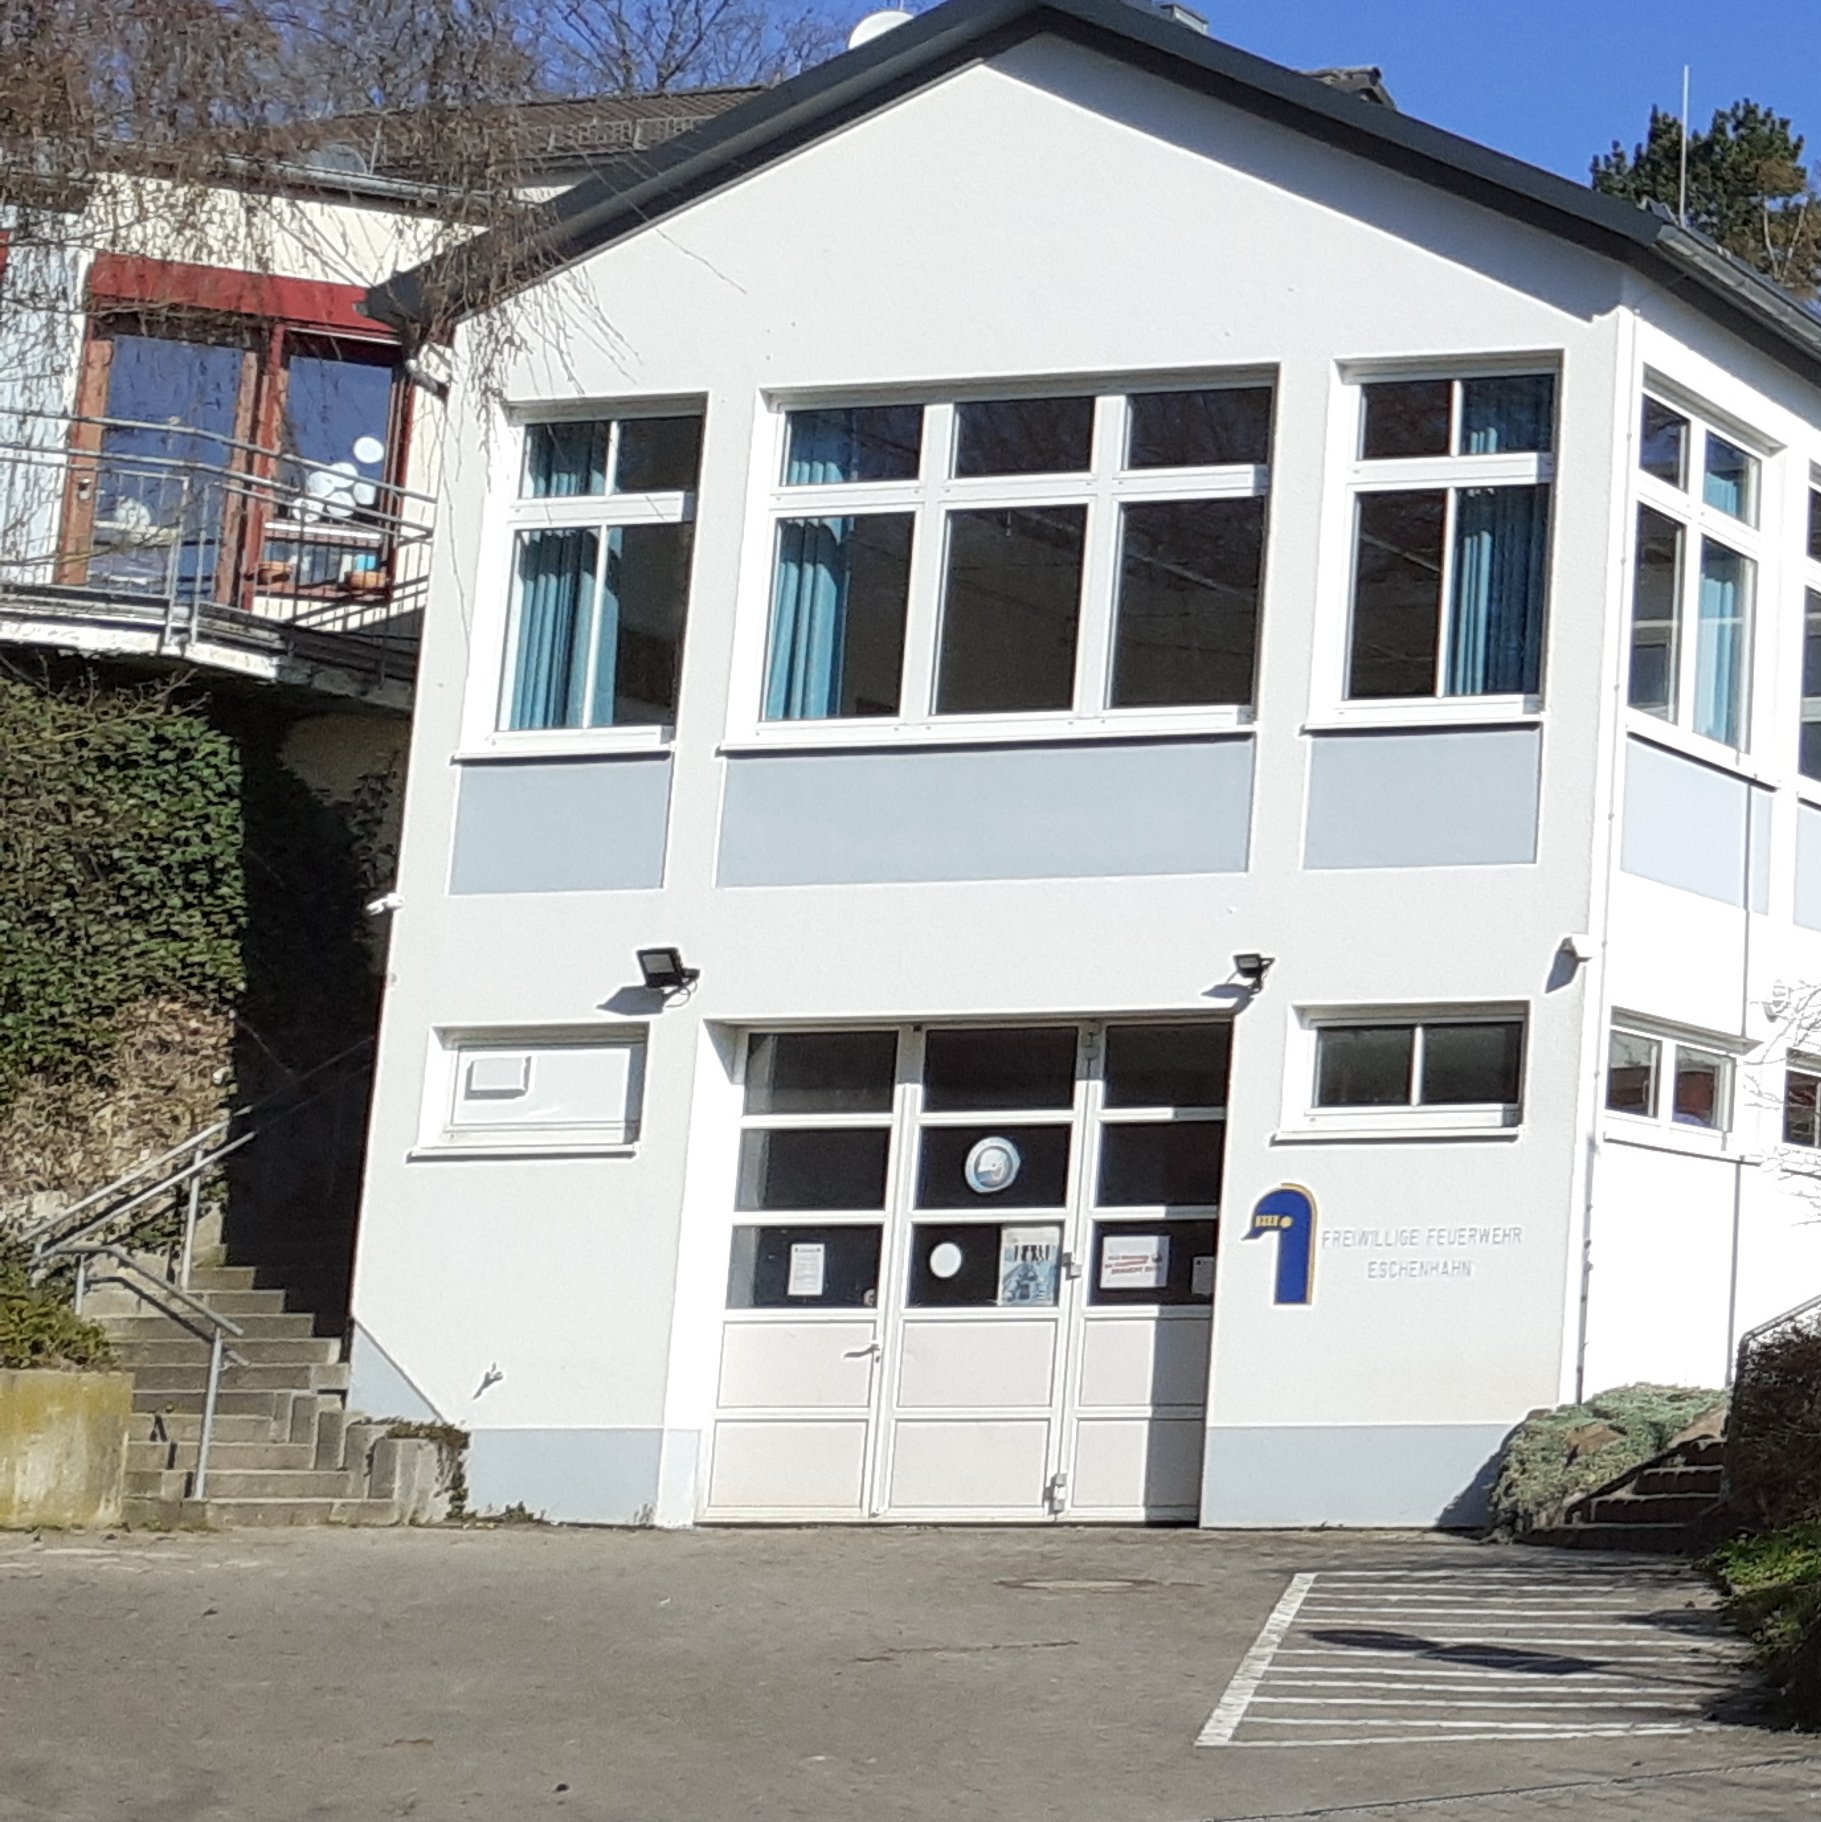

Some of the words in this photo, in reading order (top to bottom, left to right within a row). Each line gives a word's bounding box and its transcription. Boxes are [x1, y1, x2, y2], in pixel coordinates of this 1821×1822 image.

[1321, 1229, 1420, 1248] FREIWILLIGE
[1427, 1226, 1522, 1246] FEUERWEHR
[1367, 1260, 1472, 1279] ESCHENHAHN
